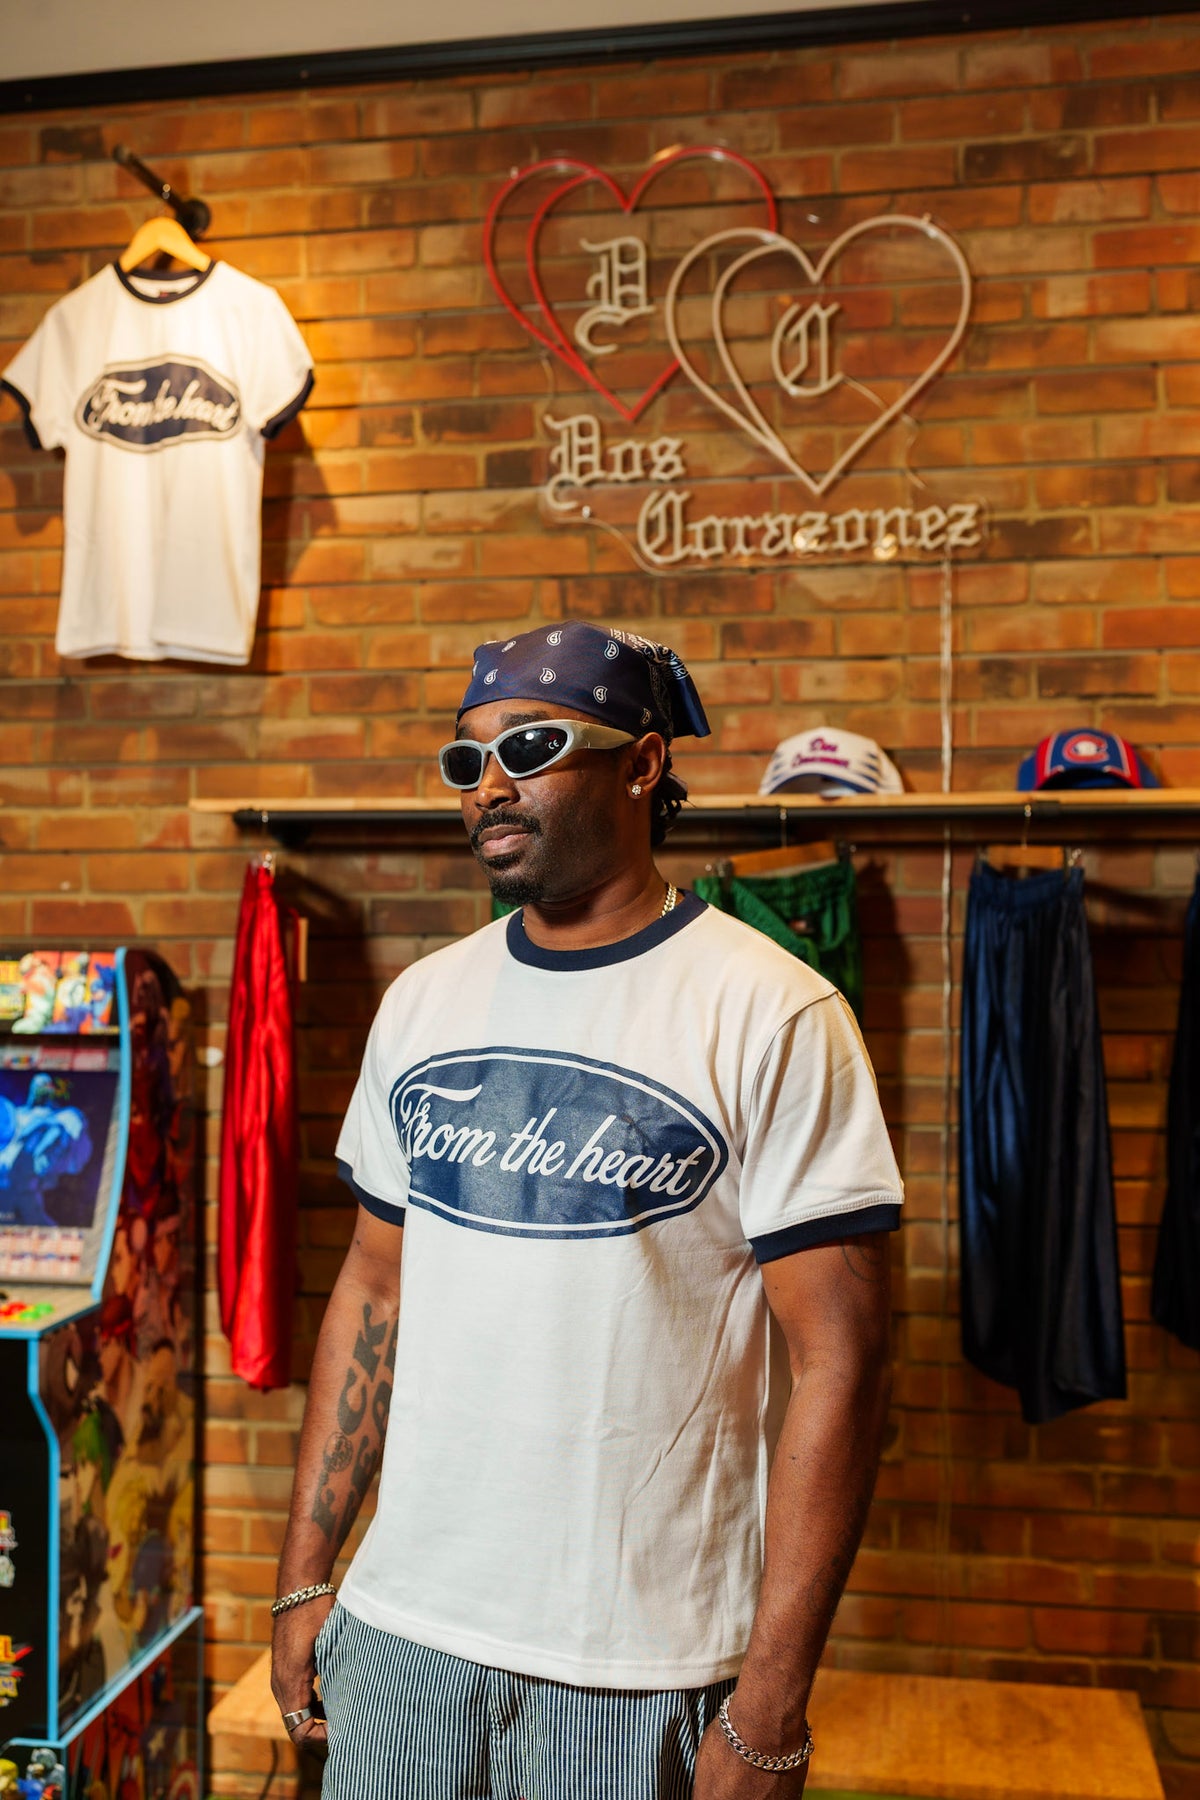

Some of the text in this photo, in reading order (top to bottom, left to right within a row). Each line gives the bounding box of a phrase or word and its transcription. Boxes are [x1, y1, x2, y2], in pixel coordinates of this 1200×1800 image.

[770, 301, 844, 397] C
[543, 414, 685, 511] Dos
[637, 490, 983, 564] Corazonez
[400, 1083, 707, 1197] From the heart
